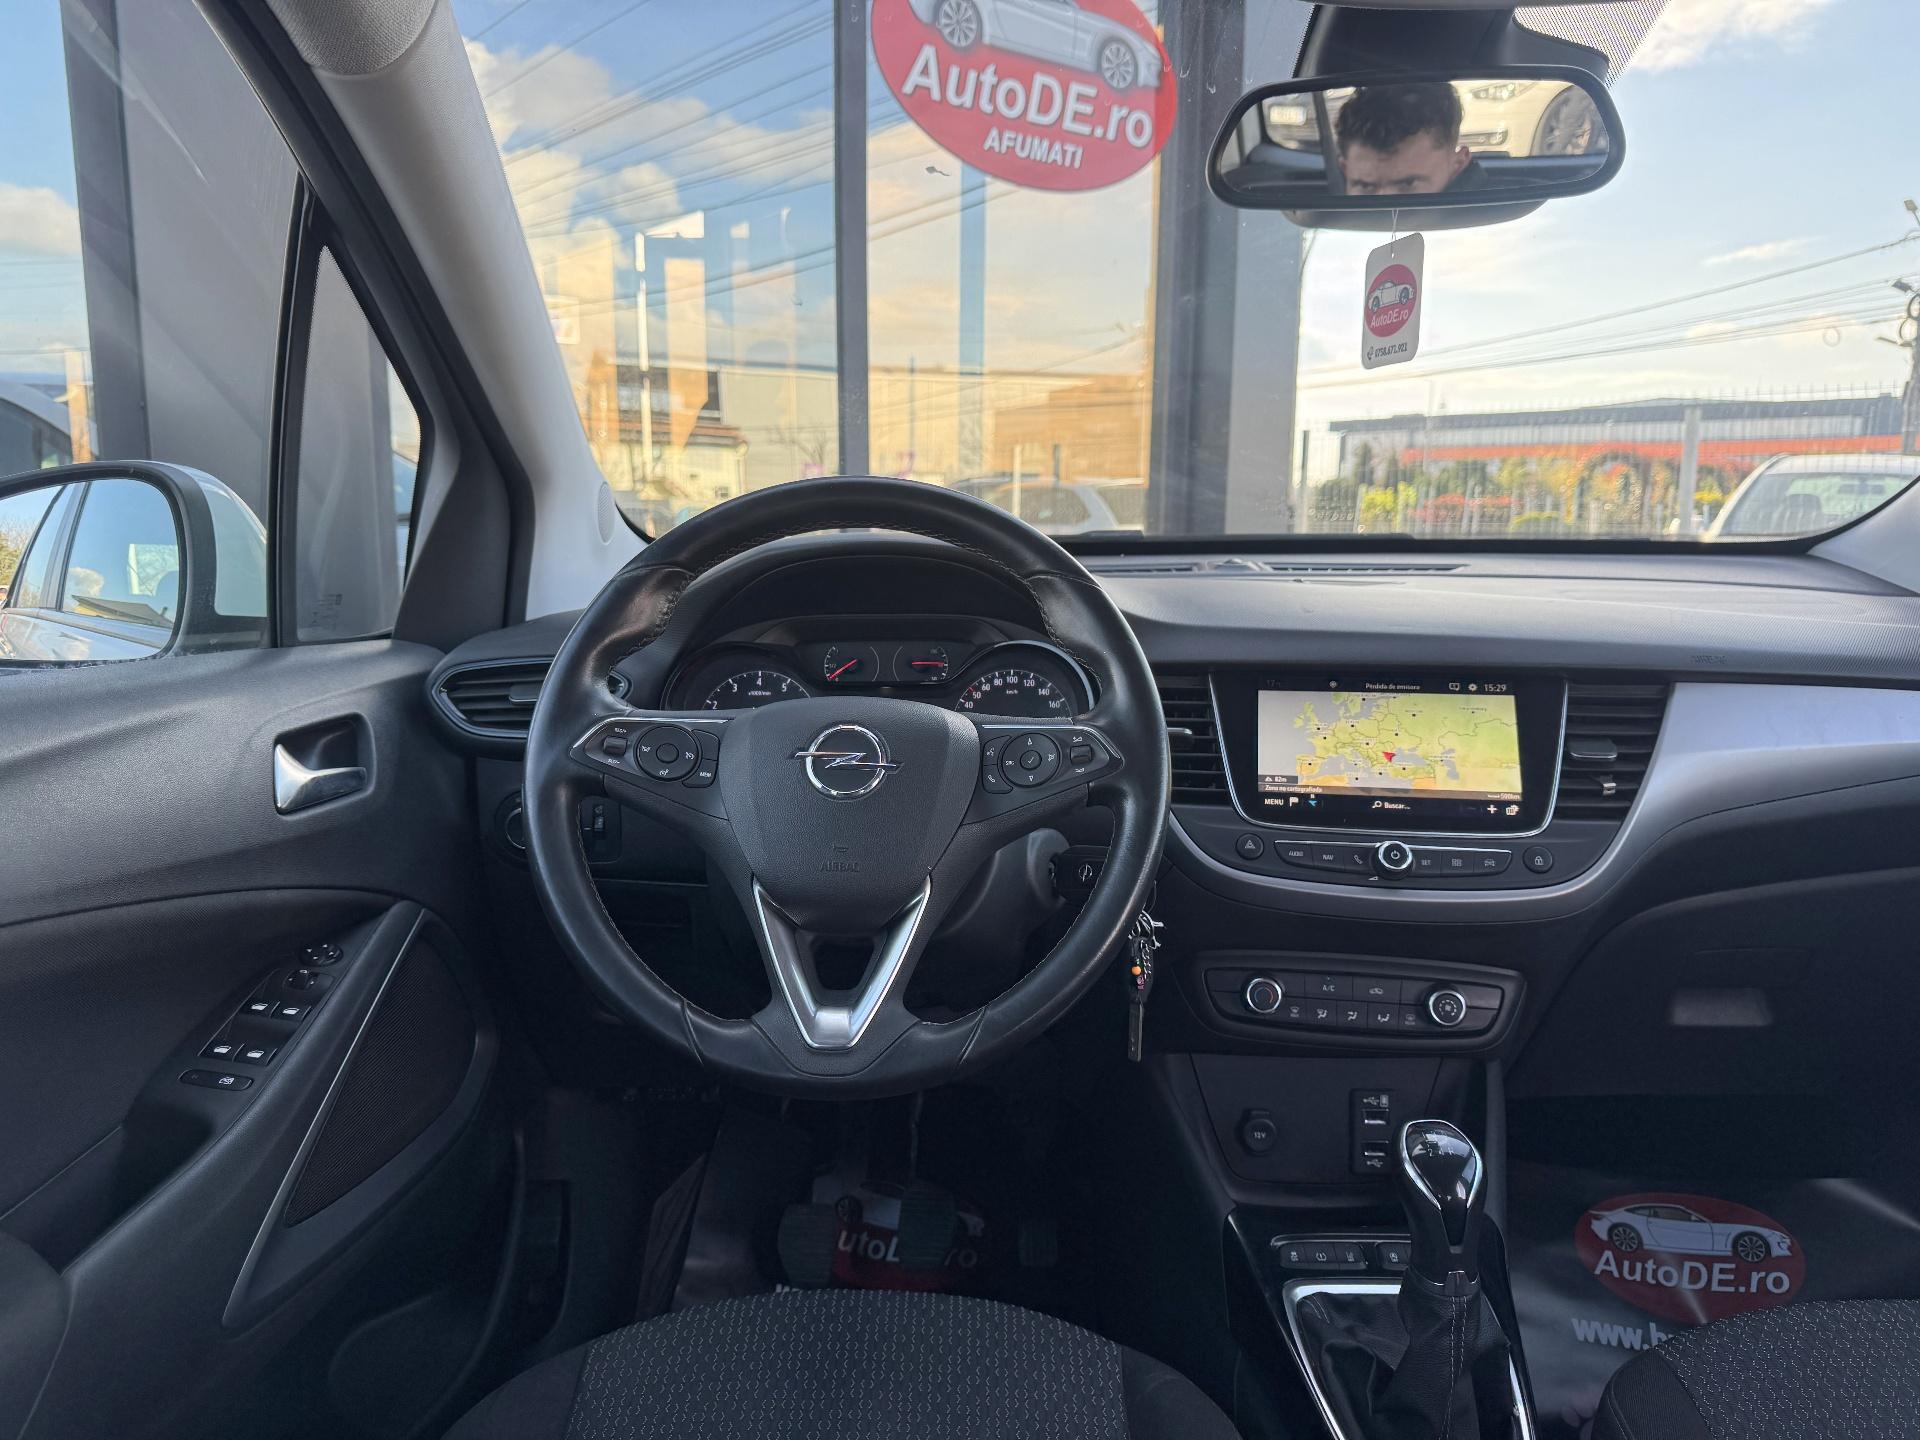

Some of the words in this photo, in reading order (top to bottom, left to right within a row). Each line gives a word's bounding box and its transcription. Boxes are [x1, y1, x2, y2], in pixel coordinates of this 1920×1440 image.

[902, 44, 1154, 148] AutoDE.ro
[983, 126, 1083, 169] AFUMATI
[1370, 308, 1409, 328] AutoDE.ro
[756, 677, 762, 686] 4
[993, 678, 1003, 687] 80
[1006, 675, 1019, 684] 100
[1023, 678, 1035, 688] 120
[732, 683, 738, 692] 3
[781, 682, 787, 692] 5
[981, 683, 991, 692] 60
[1484, 684, 1507, 693] 15:29
[972, 691, 982, 700] 50
[1038, 688, 1050, 697] 140
[712, 701, 718, 710] 2
[964, 701, 974, 709] 40
[1049, 700, 1061, 709] 160
[1265, 784, 1279, 792] Zona
[1287, 785, 1323, 794] cartografiada
[1264, 798, 1285, 806] MENU
[1322, 984, 1336, 992] A/C
[1593, 1250, 1790, 1295] AutoDE.ro
[1571, 1317, 1672, 1351] www.h
